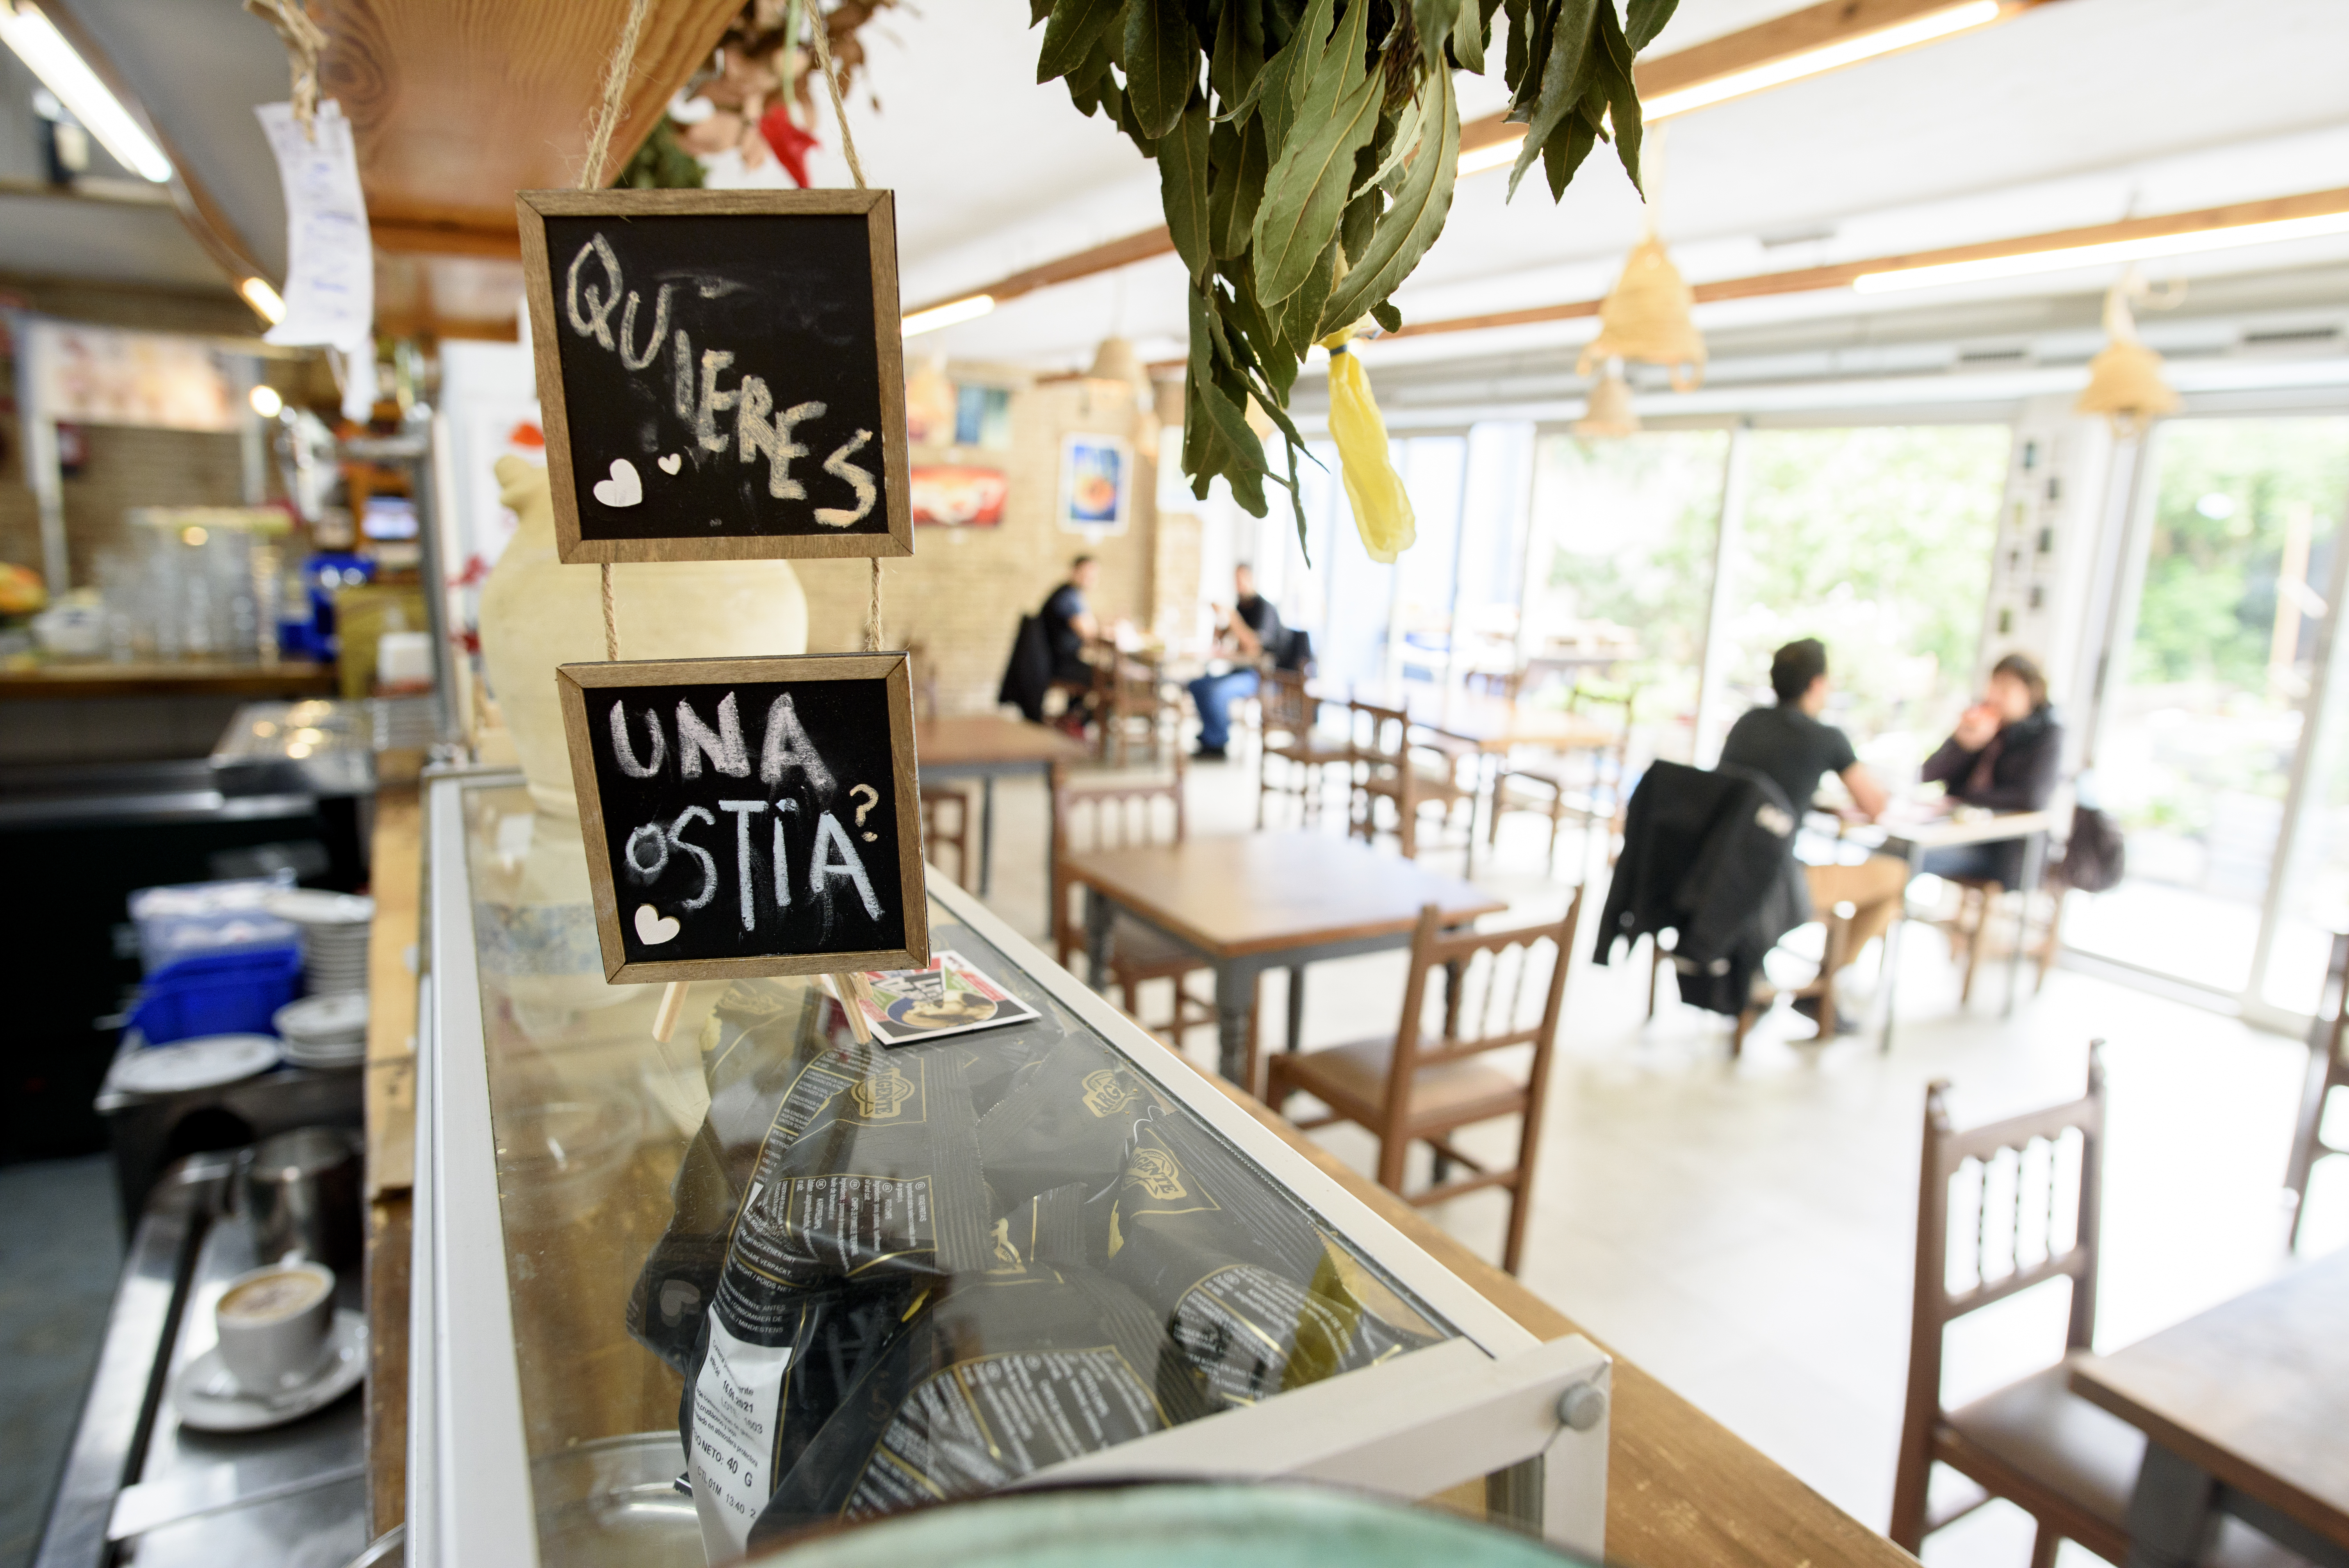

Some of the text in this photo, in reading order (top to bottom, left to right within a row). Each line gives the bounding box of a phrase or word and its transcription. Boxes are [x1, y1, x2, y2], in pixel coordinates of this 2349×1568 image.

[566, 232, 877, 527] QUIERES
[610, 691, 838, 793] UNA
[756, 1274, 777, 1290] POIDS
[733, 1301, 772, 1322] CONSOMMER
[762, 1304, 787, 1313] ANTES
[738, 1319, 784, 1333] MINDESTENS
[701, 1440, 724, 1466] NETO:
[727, 1457, 739, 1474] 40
[744, 1471, 753, 1488] G
